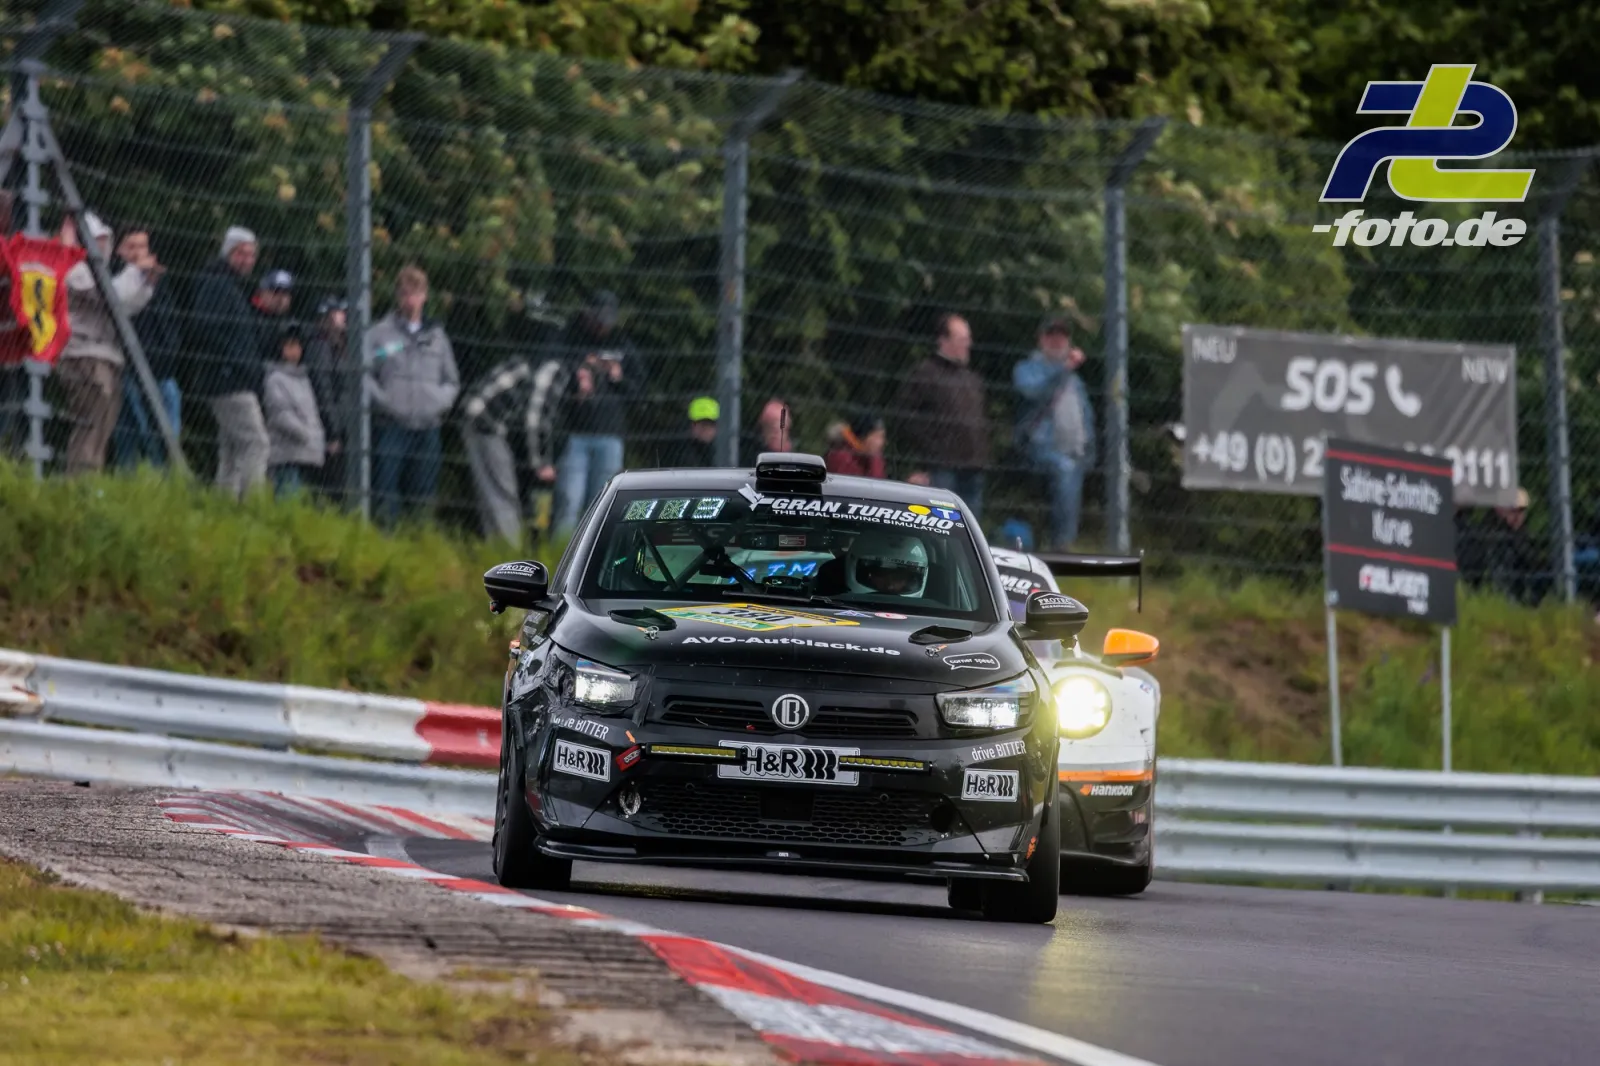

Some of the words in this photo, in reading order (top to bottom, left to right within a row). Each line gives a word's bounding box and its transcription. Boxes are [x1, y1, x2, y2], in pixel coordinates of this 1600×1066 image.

[1192, 335, 1238, 364] NEU
[1461, 355, 1509, 385] NEW
[1281, 355, 1378, 415] SOS
[1191, 430, 1248, 472] +49
[1254, 431, 1297, 486] (0)
[1302, 435, 1325, 477] 2
[771, 498, 842, 514] GRAN
[848, 503, 954, 530] TURISMO
[799, 509, 831, 518] REAL
[832, 512, 880, 523] DRIVING
[883, 519, 951, 536] SIMULATOR
[682, 636, 901, 656] AVO-Autolack.de
[575, 718, 610, 740] BITTER
[557, 745, 587, 772] H&R
[739, 746, 806, 779] H&R
[971, 746, 996, 761] drive
[995, 740, 1027, 758] BITTER
[965, 773, 997, 796] H&R
